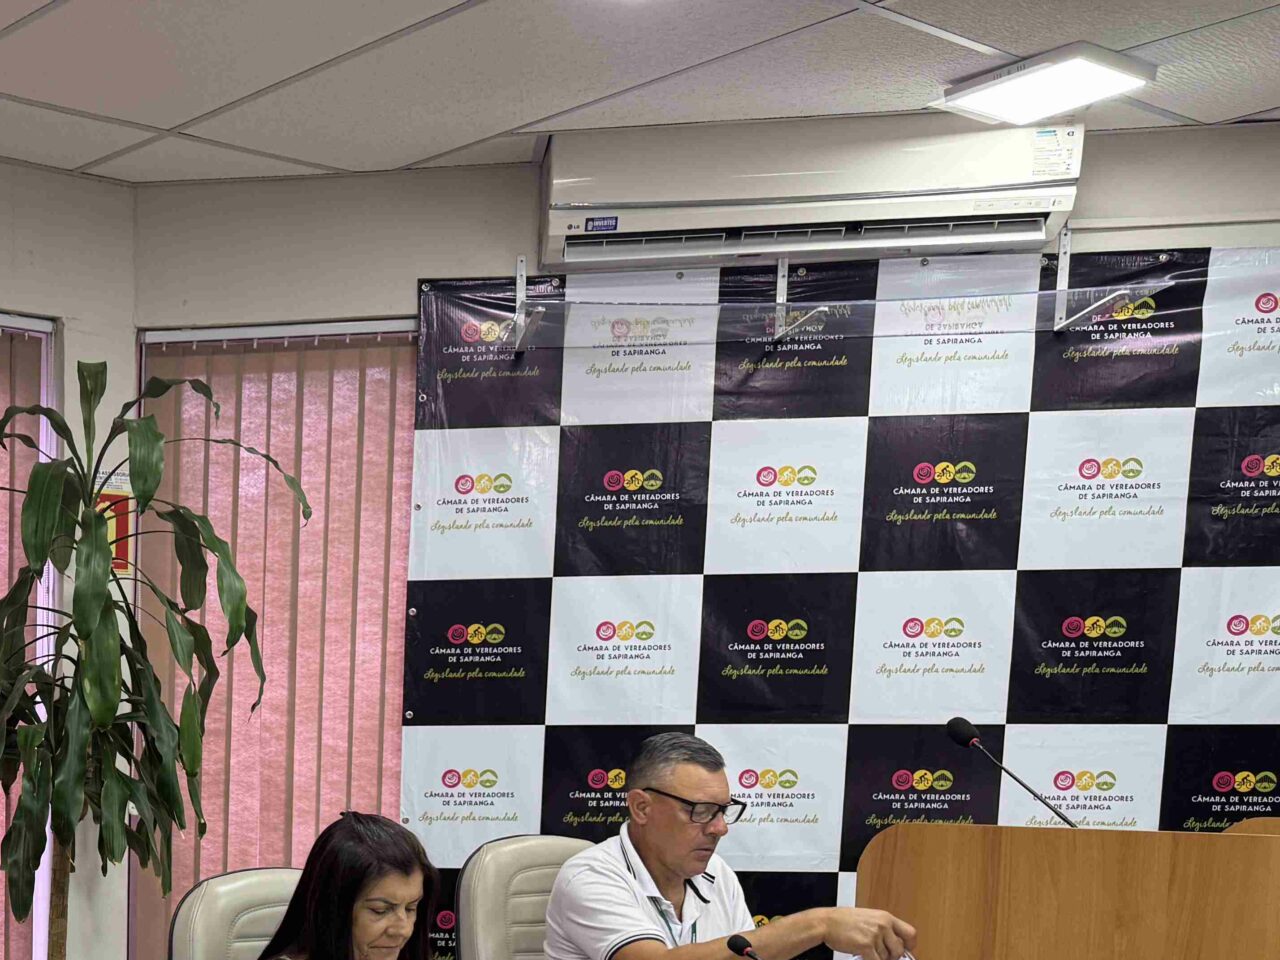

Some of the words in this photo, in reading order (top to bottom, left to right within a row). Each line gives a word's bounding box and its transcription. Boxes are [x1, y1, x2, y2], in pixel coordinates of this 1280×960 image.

[1121, 321, 1174, 330] VEREADORES
[1103, 331, 1151, 340] SAPIRANGA
[777, 343, 822, 351] SAPIRANGA
[1111, 345, 1131, 358] pela
[1131, 344, 1178, 356] comunidade
[623, 348, 666, 356] SAPIRANGA
[784, 357, 802, 369] pela
[803, 355, 847, 367] comunidade
[630, 362, 647, 374] pela
[648, 361, 691, 372] comunidade
[892, 486, 927, 494] CÂMARA
[942, 486, 993, 494] VEREADORES
[1057, 482, 1093, 491] CÂMARA
[1108, 482, 1161, 490] VEREADORES
[584, 493, 617, 501] CÂMARA
[736, 489, 770, 498] CÂMARA
[785, 489, 834, 497] VEREADORES
[436, 497, 468, 505] CÂMARA
[768, 498, 813, 506] SAPIRANGA
[925, 495, 971, 503] SAPIRANGA
[615, 502, 658, 510] SAPIRANGA
[885, 509, 930, 525] Legislando
[932, 509, 951, 521] pela
[952, 508, 997, 519] comunidade
[1049, 506, 1096, 521] Legislando
[1098, 506, 1117, 518] pela
[1118, 505, 1164, 516] comunidade
[578, 515, 620, 531] Legislando
[622, 515, 640, 527] pela
[641, 515, 683, 525] comunidade
[729, 512, 773, 527] Legislando
[775, 512, 793, 524] pela
[794, 511, 838, 522] comunidade
[430, 519, 471, 534] Legislando
[473, 519, 490, 530] pela
[491, 518, 532, 529] comunidade
[577, 643, 609, 651] CÂMARA
[728, 642, 761, 650] CÂMARA
[1041, 640, 1077, 648] CÂMARA
[429, 646, 461, 654] CÂMARA
[423, 667, 464, 681] Legislando
[466, 668, 483, 679] pela
[484, 668, 524, 677] comunidade
[570, 666, 612, 680] Legislando
[614, 666, 631, 677] pela
[632, 666, 674, 676] comunidade
[720, 664, 764, 679] Legislando
[766, 664, 783, 676] pela
[784, 665, 827, 674] comunidade
[874, 663, 919, 678] Legislando
[921, 663, 940, 675] pela
[940, 664, 985, 673] comunidade
[1033, 663, 1080, 677] Legislando
[1081, 663, 1100, 675] pela
[1101, 663, 1147, 673] comunidade
[872, 792, 906, 800] CÂMARA
[1190, 794, 1226, 802] CÂMARA
[417, 811, 458, 825] Legislando
[460, 812, 476, 823] pela
[477, 812, 517, 822] comunidade
[1092, 817, 1137, 827] comunidade
[1182, 817, 1229, 832] Legislando
